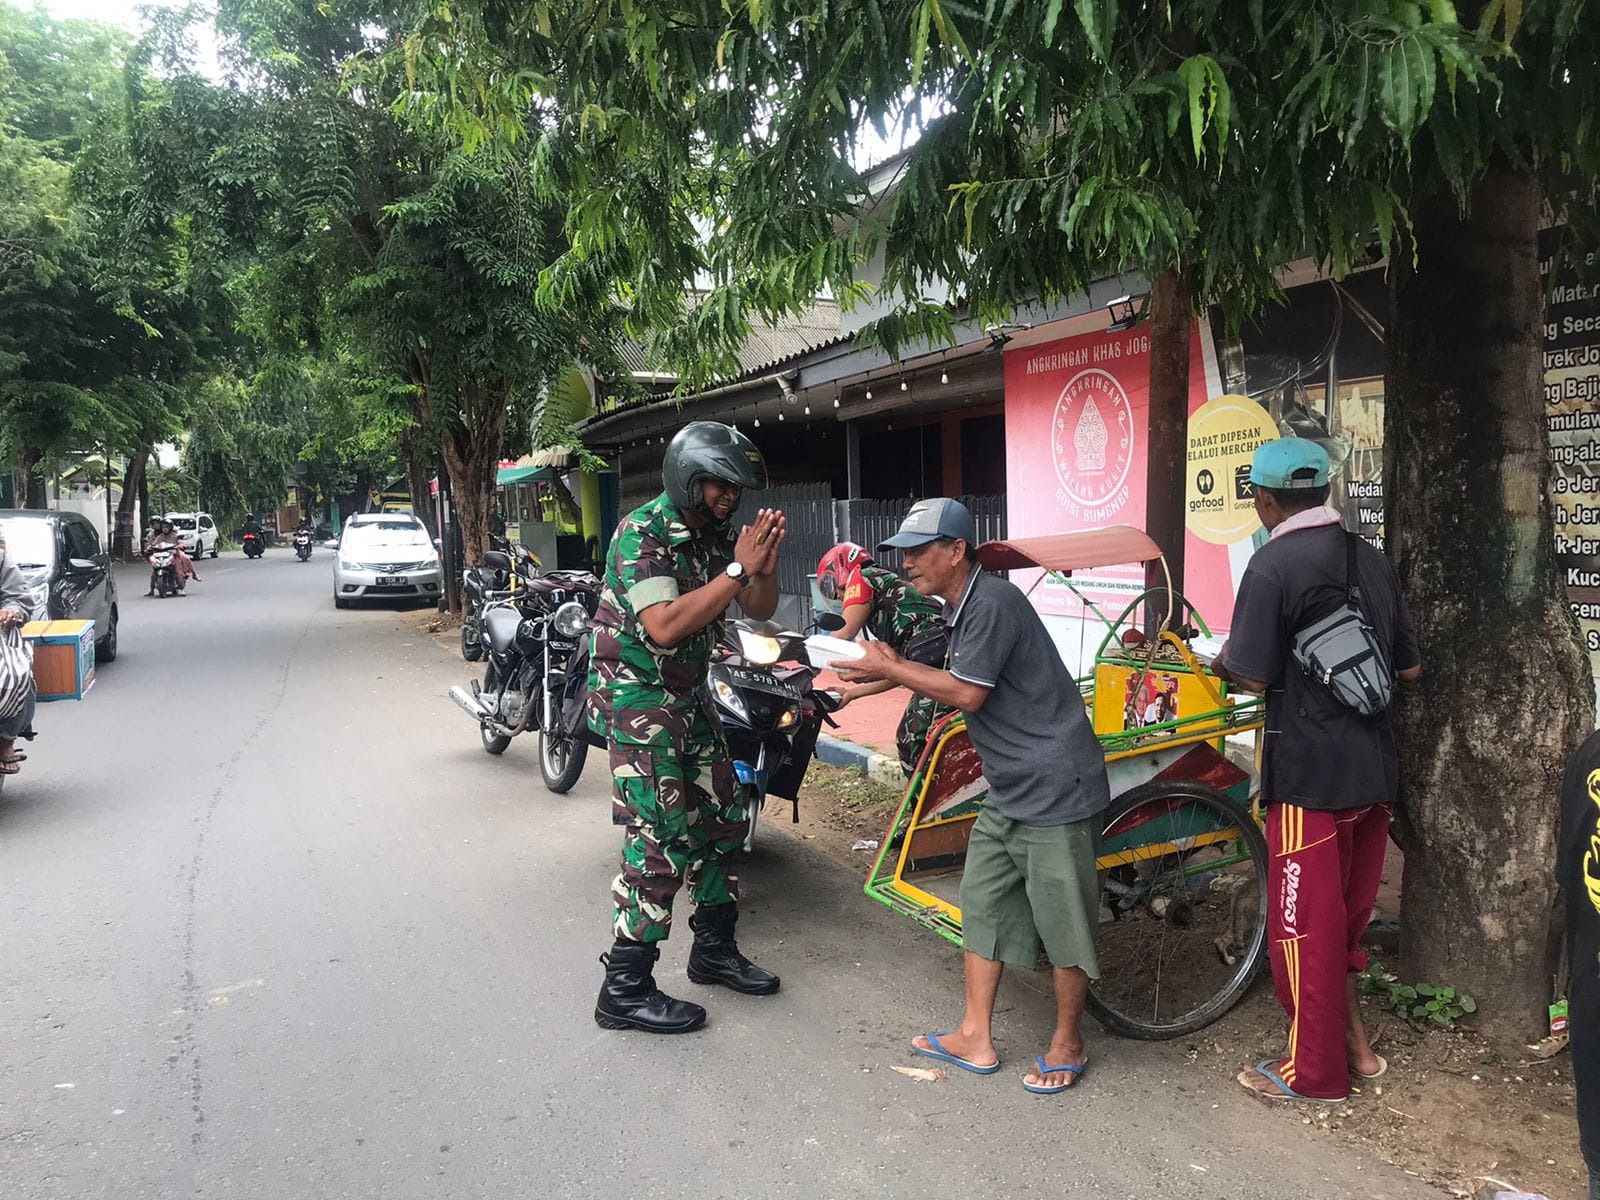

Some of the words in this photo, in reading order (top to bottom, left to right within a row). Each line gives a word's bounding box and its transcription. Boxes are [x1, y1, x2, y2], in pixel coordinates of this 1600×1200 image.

[1027, 348, 1088, 375] ANGKRINGAN
[1093, 341, 1121, 362] KHAS
[1061, 376, 1121, 414] ANGKRINGAN
[1190, 434, 1219, 448] DAPAT
[1220, 427, 1261, 443] DIPESAN
[1099, 454, 1126, 495] KULIT
[1083, 484, 1130, 522] SUMENEP
[1189, 496, 1224, 512] gofood
[733, 670, 747, 679] AE
